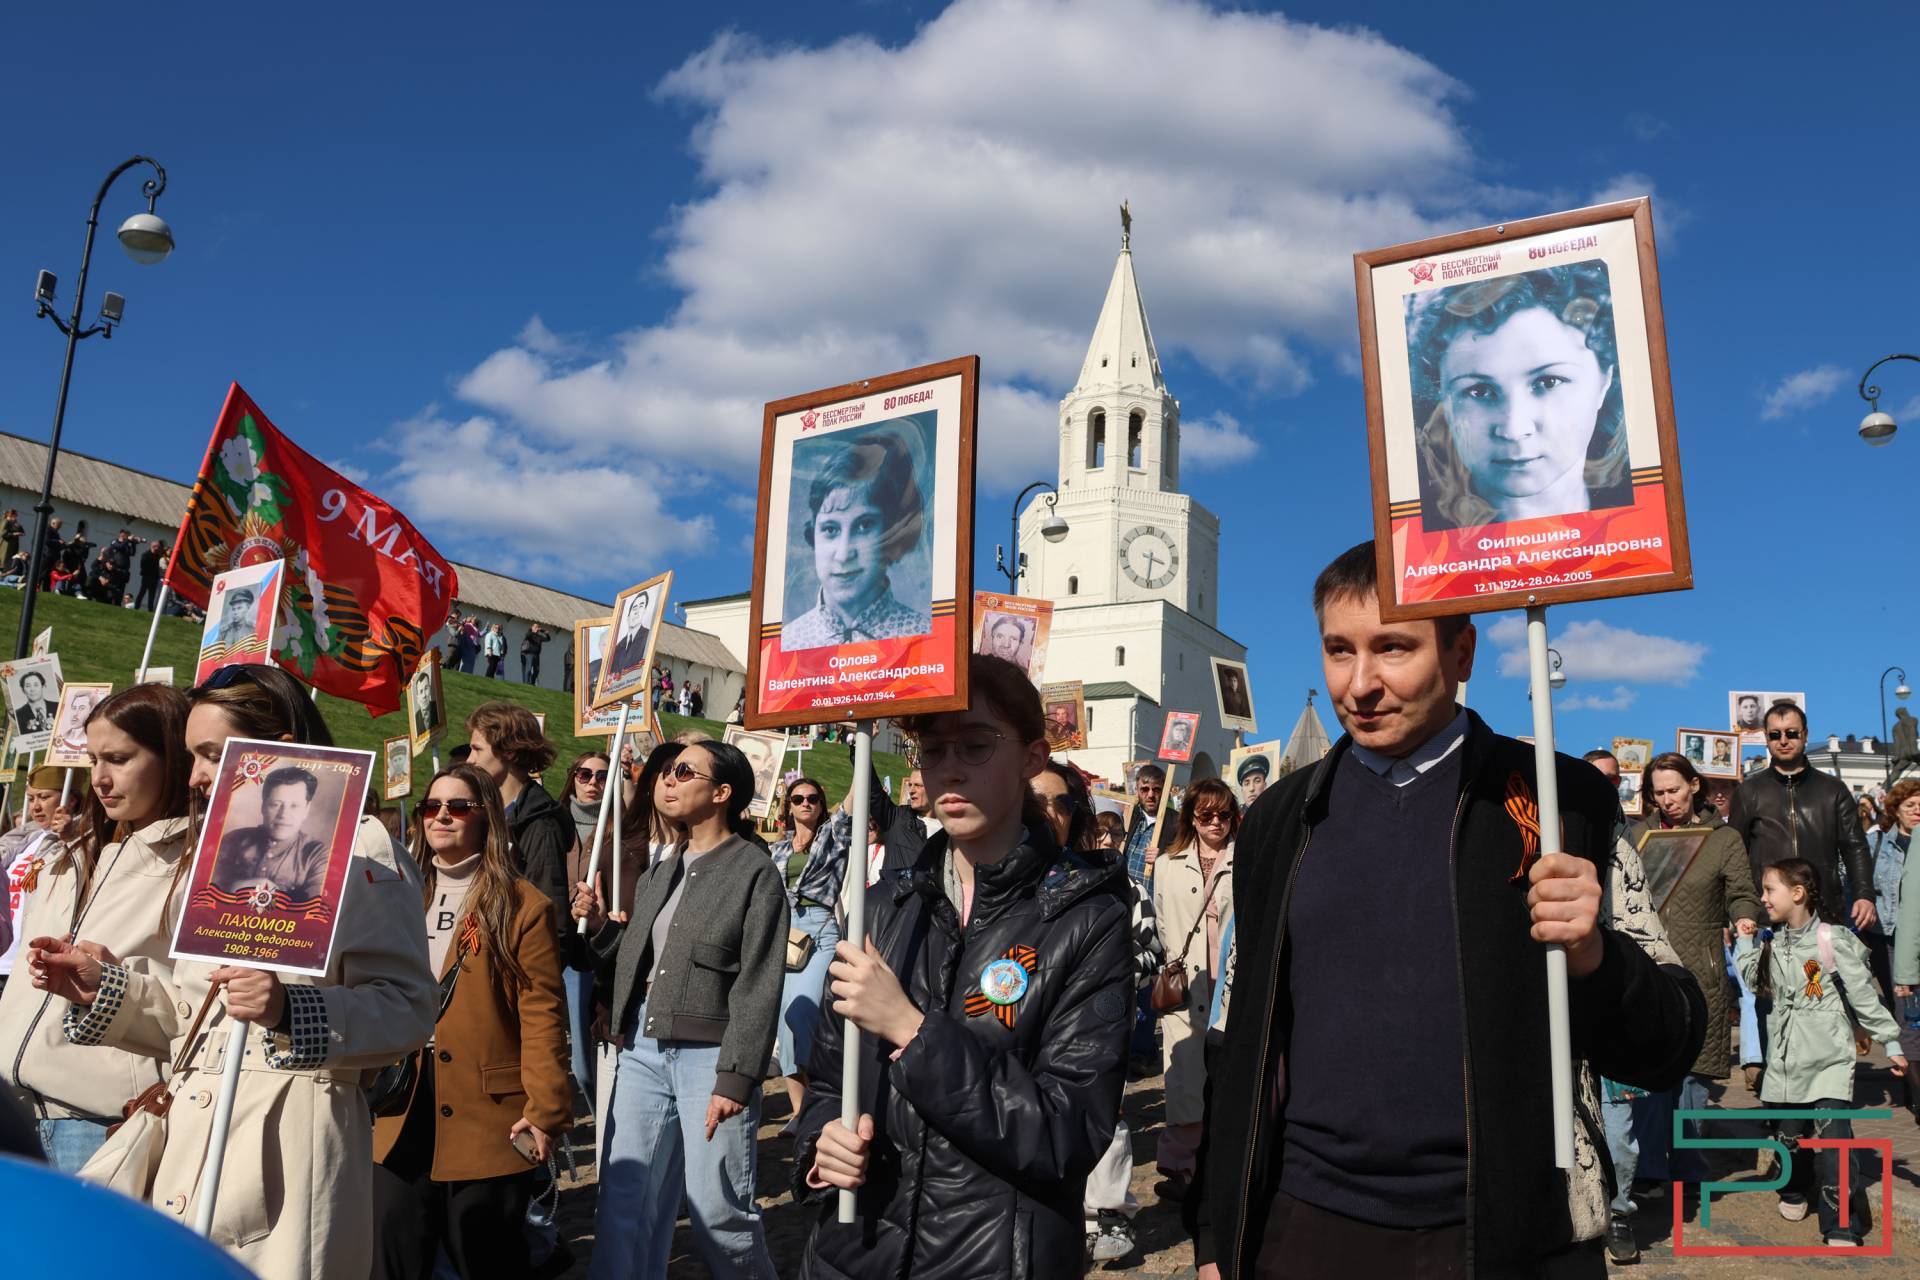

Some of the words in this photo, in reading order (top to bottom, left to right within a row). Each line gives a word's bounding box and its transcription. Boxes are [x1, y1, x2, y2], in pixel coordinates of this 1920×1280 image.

[1528, 246, 1546, 260] 80
[1548, 235, 1598, 255] ПОБЕДА!
[1441, 251, 1501, 271] БЕССМЕРТНЫЙ
[1442, 266, 1464, 280] ПОЛК
[1466, 262, 1499, 277] РОССИИ
[883, 396, 897, 411] 80
[898, 389, 934, 406] ПОБЕДА!
[822, 402, 866, 420] БЕССМЕРТНЫЙ
[822, 416, 838, 428] ПОЛК
[838, 412, 862, 425] РОССИИ
[316, 488, 347, 522] 9
[347, 504, 445, 600] МАЯ
[1477, 527, 1581, 551] Филюшина
[1405, 554, 1512, 578] Александра
[1517, 535, 1663, 564] Александровна
[1473, 570, 1593, 593] 12.11.1924-28.04.2005
[829, 654, 878, 669] Орлова
[768, 674, 835, 691] Валентина
[838, 663, 945, 684] Александровна
[811, 691, 896, 707] 20.01.1926-14.07.1944
[218, 912, 296, 933] ПАХОМОВ
[194, 926, 252, 942] Александр
[254, 932, 314, 949] Федорович
[222, 943, 280, 959] 1908-1966
